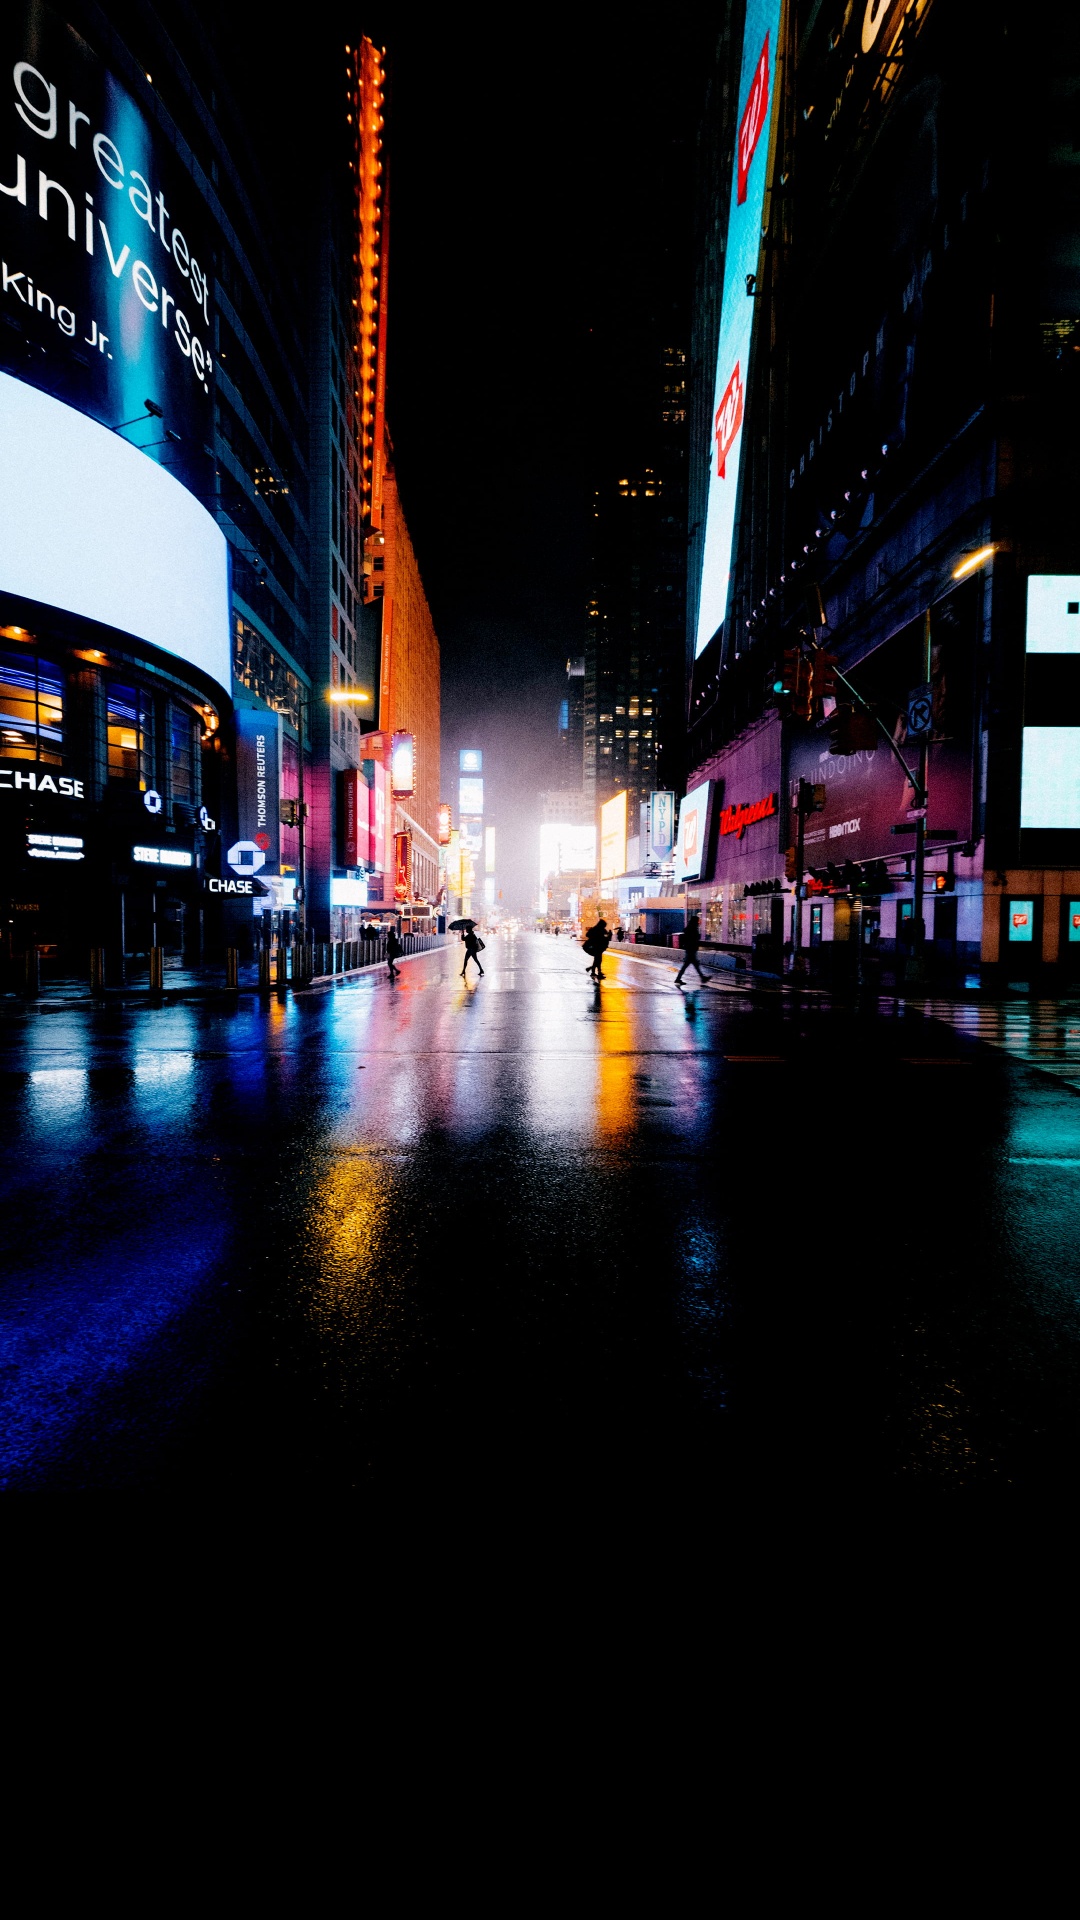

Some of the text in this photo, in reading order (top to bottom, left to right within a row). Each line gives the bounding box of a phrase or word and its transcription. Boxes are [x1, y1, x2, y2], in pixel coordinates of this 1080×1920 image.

[13, 61, 209, 326] greatest
[2, 258, 113, 361] King Jr.
[257, 734, 267, 828] THOMSON REUTERS
[719, 791, 775, 840] Walgreens
[658, 795, 667, 845] NYPD
[208, 878, 253, 895] CHASE
